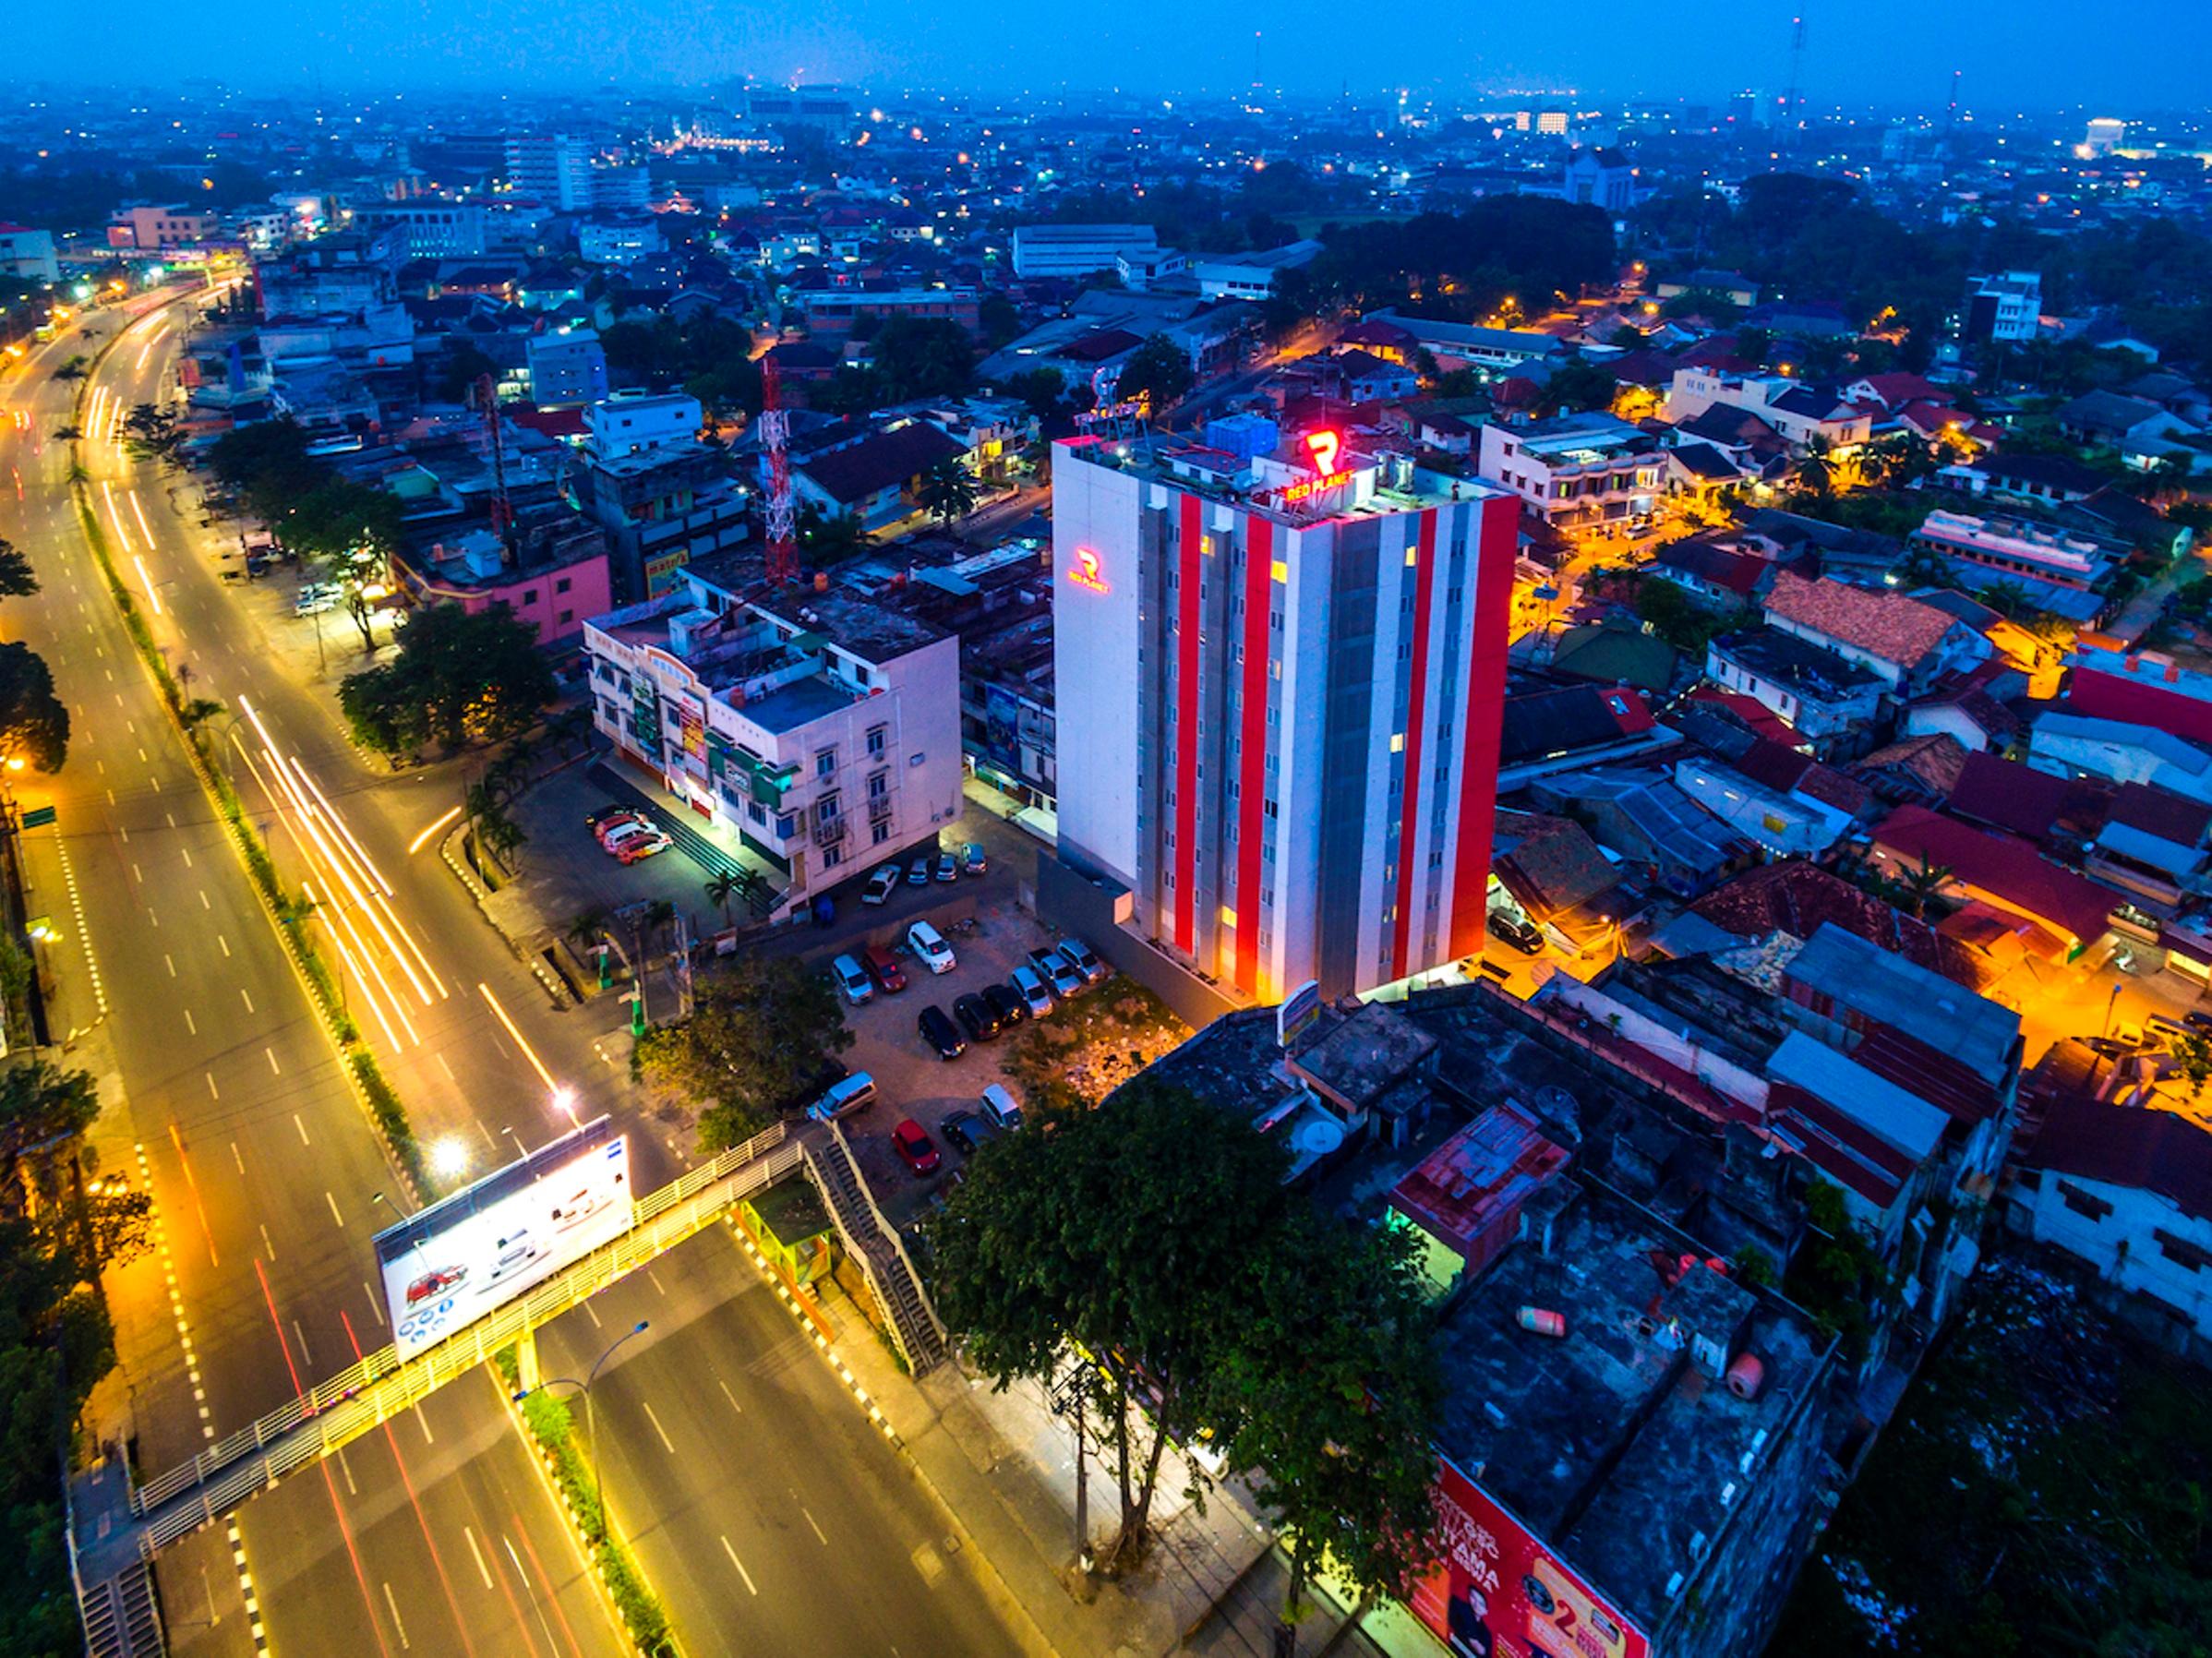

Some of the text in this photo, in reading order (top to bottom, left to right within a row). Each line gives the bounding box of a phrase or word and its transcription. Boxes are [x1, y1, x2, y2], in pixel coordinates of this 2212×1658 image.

[1287, 469, 1354, 501] RED PLANET
[1554, 1599, 1577, 1639] 2
